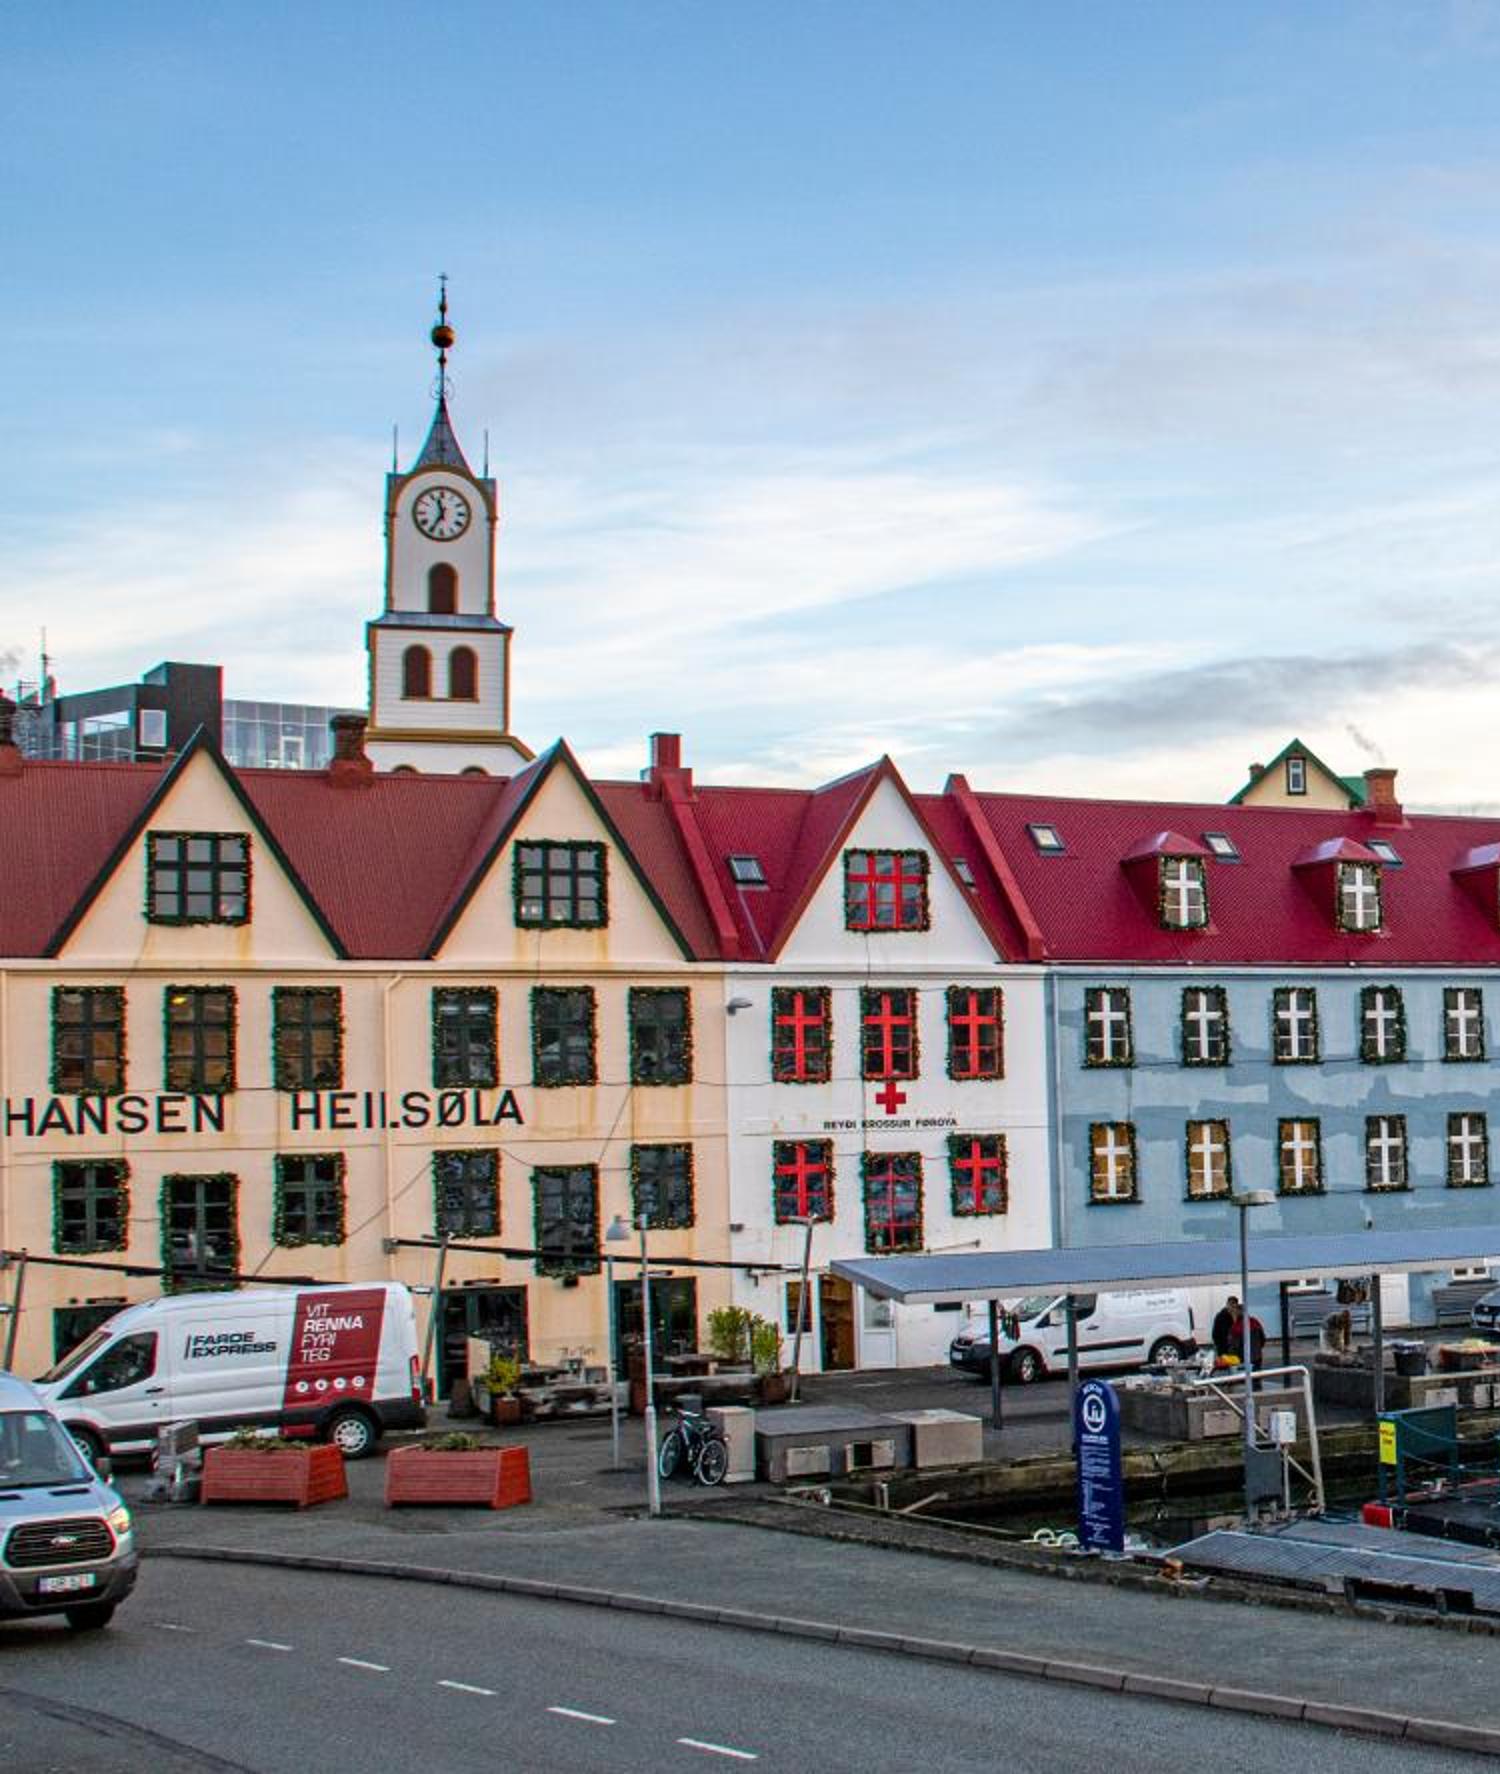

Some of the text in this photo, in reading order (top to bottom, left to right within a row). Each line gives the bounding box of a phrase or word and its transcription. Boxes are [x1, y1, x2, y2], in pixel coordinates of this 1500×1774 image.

[5, 1090, 524, 1137] HANSEN HEILSØLA
[306, 1304, 332, 1317] VIT
[303, 1316, 363, 1332] RENNA
[302, 1332, 337, 1347] FYRI
[192, 1342, 278, 1359] EXPRESS
[301, 1348, 331, 1363] TEG
